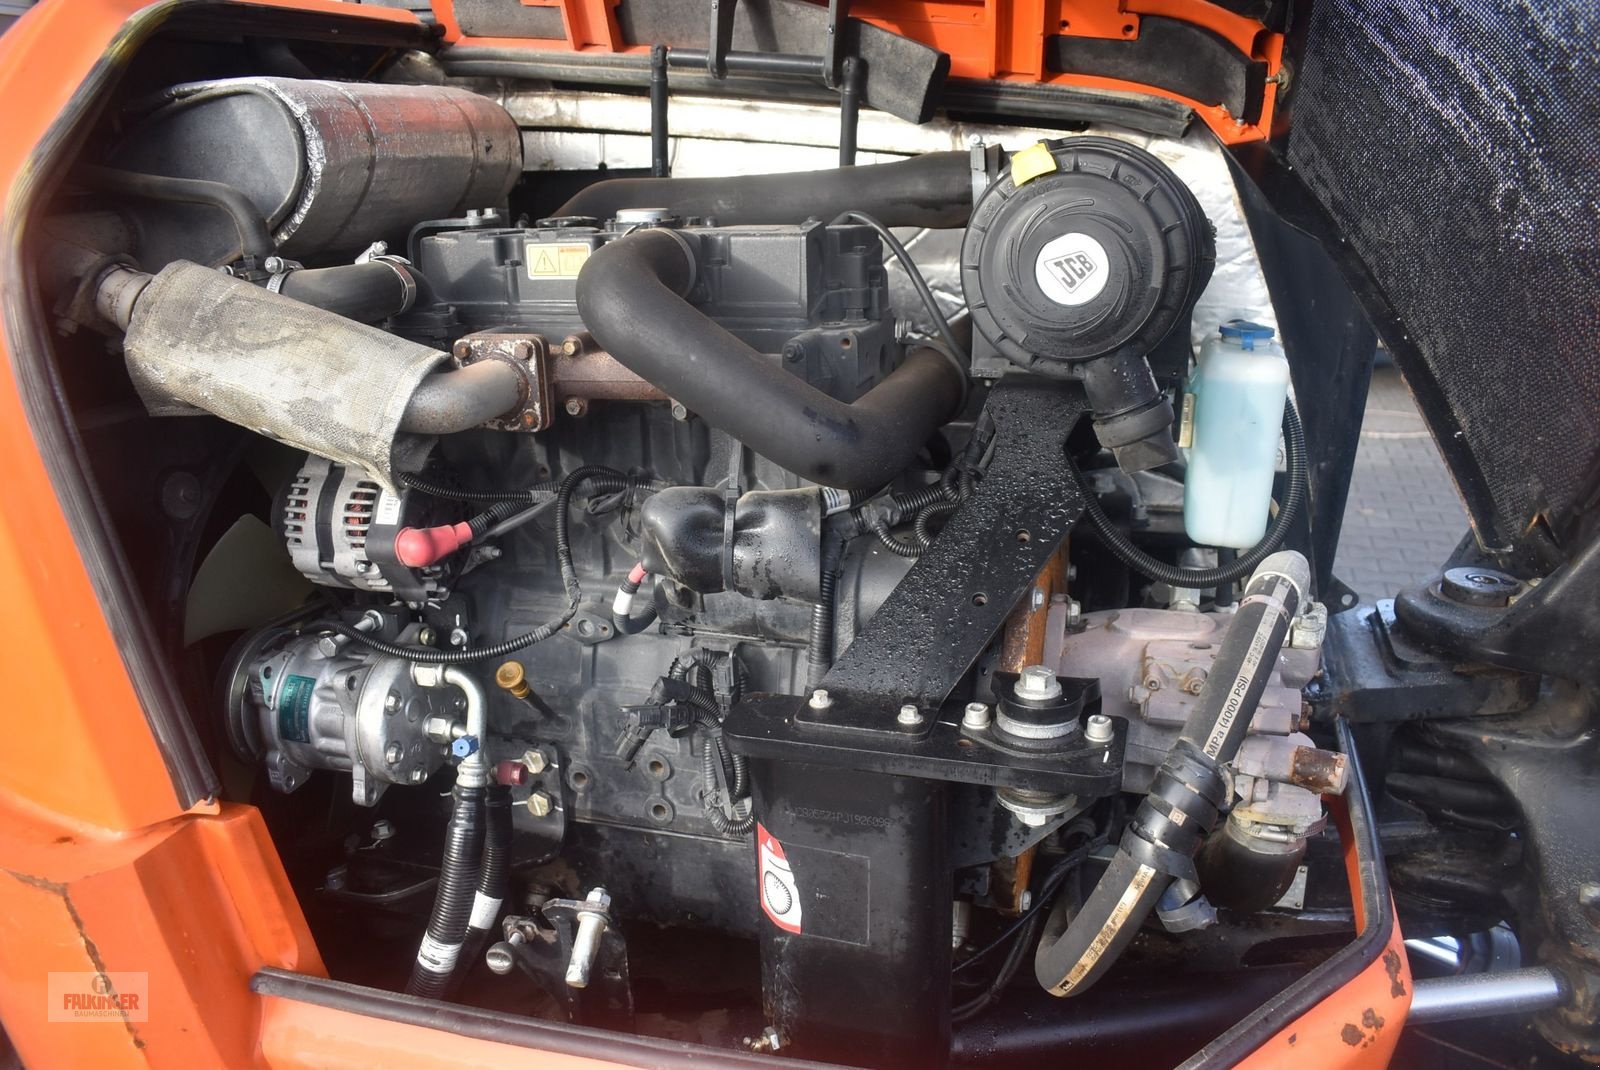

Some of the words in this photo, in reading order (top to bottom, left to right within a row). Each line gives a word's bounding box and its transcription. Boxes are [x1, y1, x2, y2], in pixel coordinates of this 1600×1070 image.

[1053, 254, 1093, 288] JCB
[1207, 730, 1225, 757] MPa
[1219, 698, 1239, 729] (4000
[1234, 675, 1249, 698] PSI)
